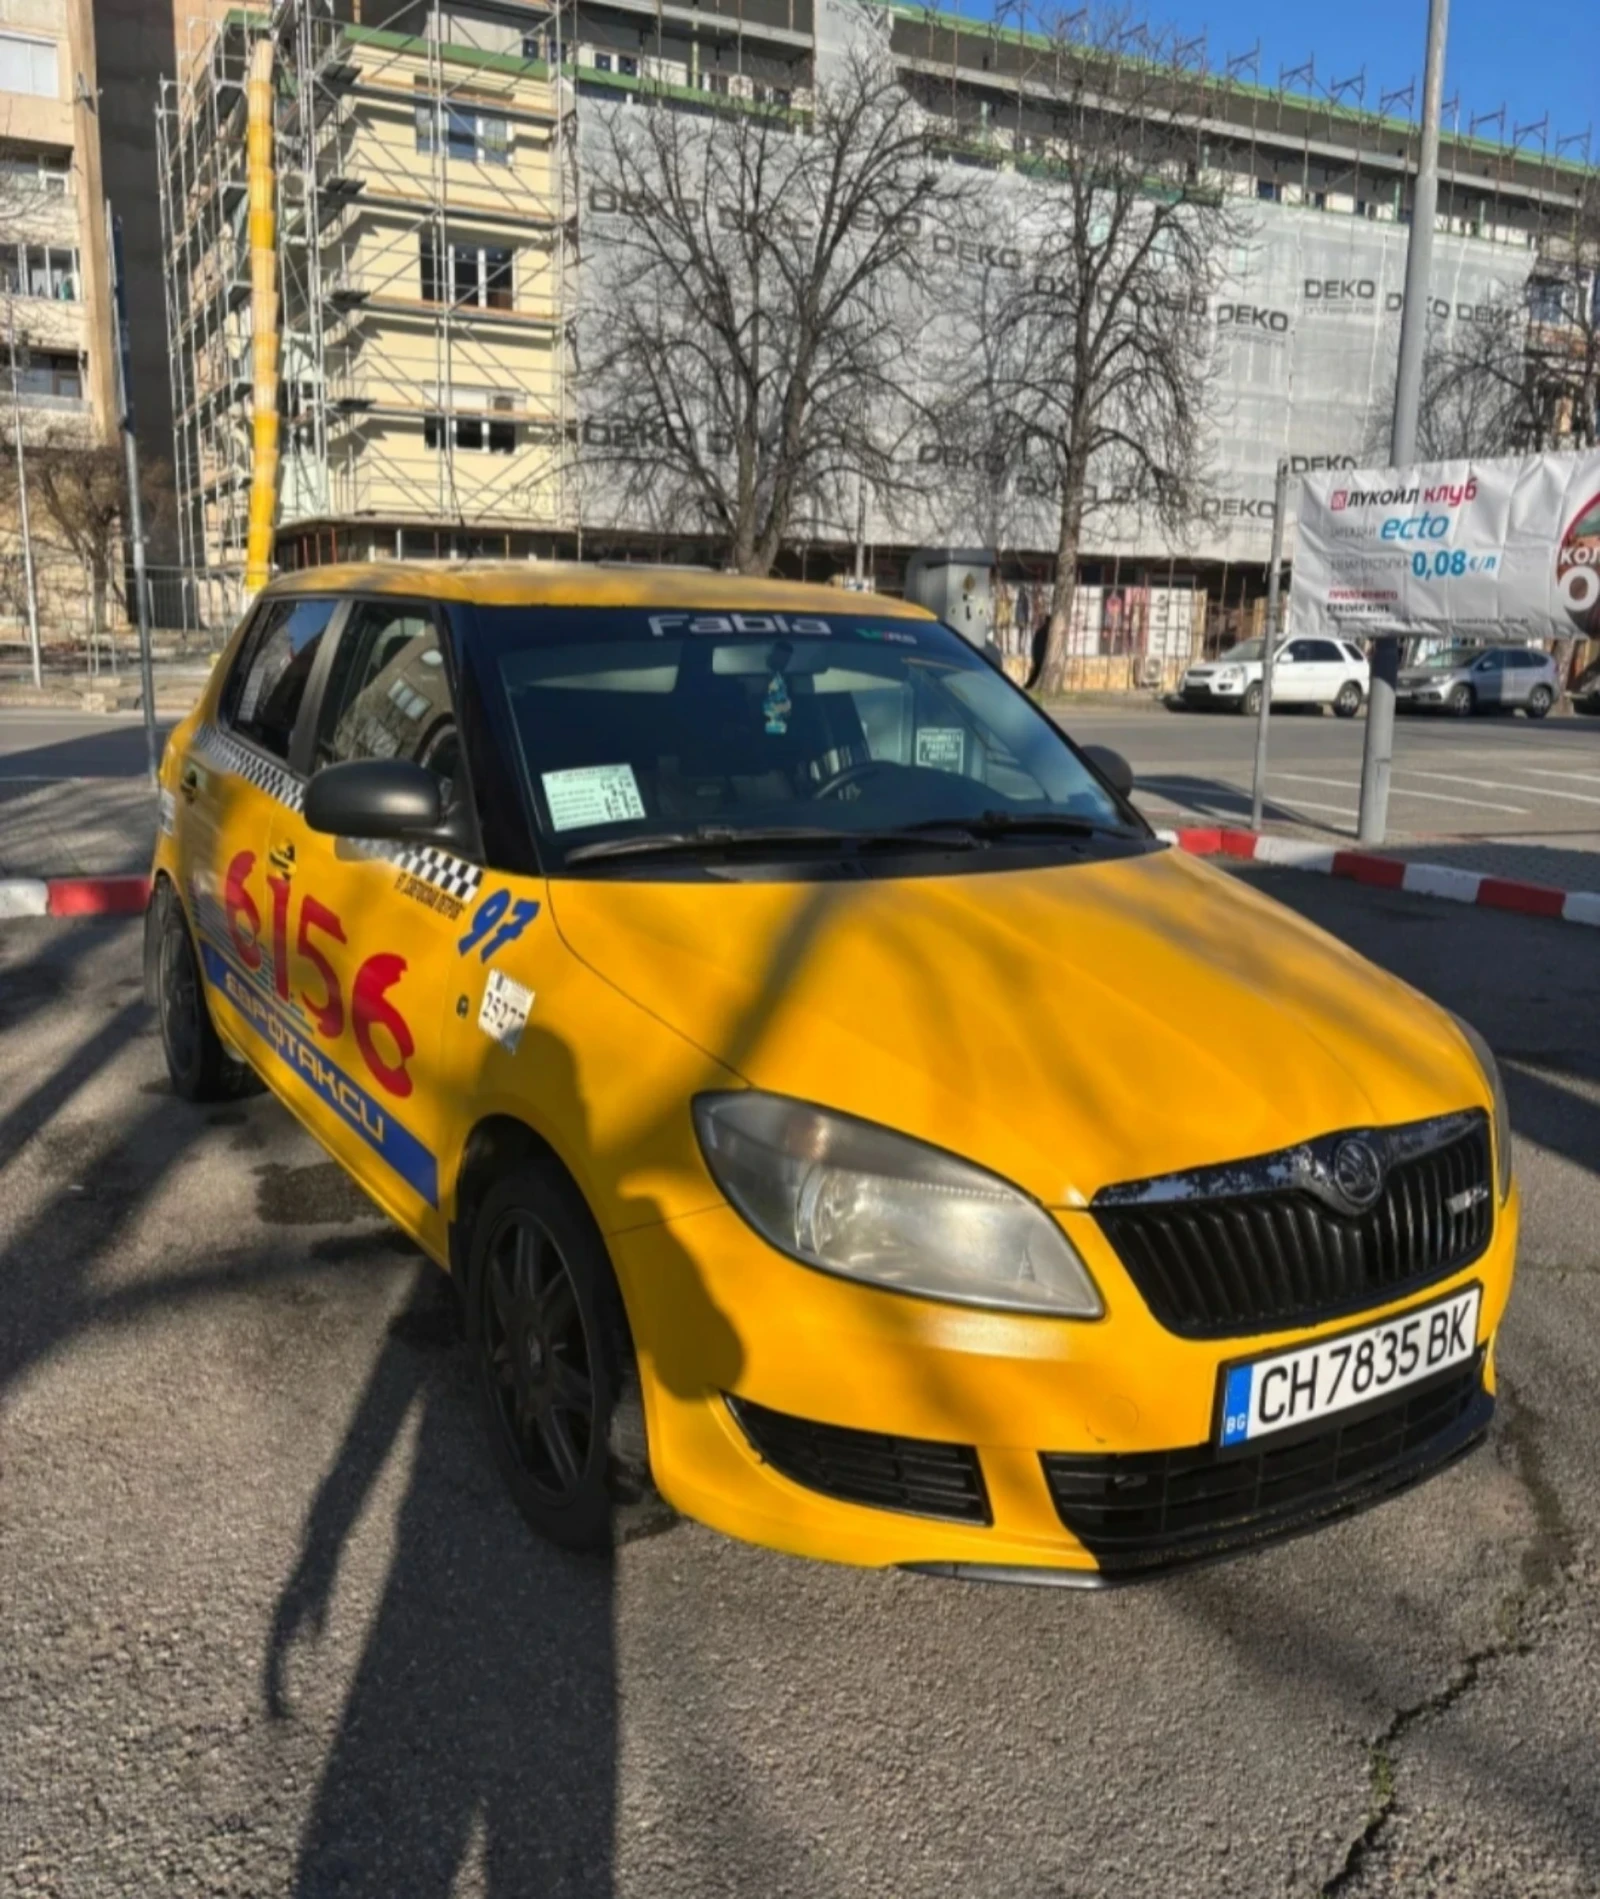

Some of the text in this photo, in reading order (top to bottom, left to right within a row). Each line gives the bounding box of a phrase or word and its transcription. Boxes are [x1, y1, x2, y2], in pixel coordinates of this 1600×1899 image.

[1305, 279, 1375, 299] DEKO
[1217, 304, 1288, 332] DEKO
[1347, 477, 1478, 508] ЛУКОЙЛ клуб
[1201, 498, 1277, 520] DEKO
[1380, 511, 1450, 540] ecto
[1412, 550, 1466, 581] 0,08
[648, 613, 832, 637] Fabia
[458, 889, 541, 964] 97
[224, 850, 415, 1098] 6156
[1225, 1413, 1246, 1434] BG
